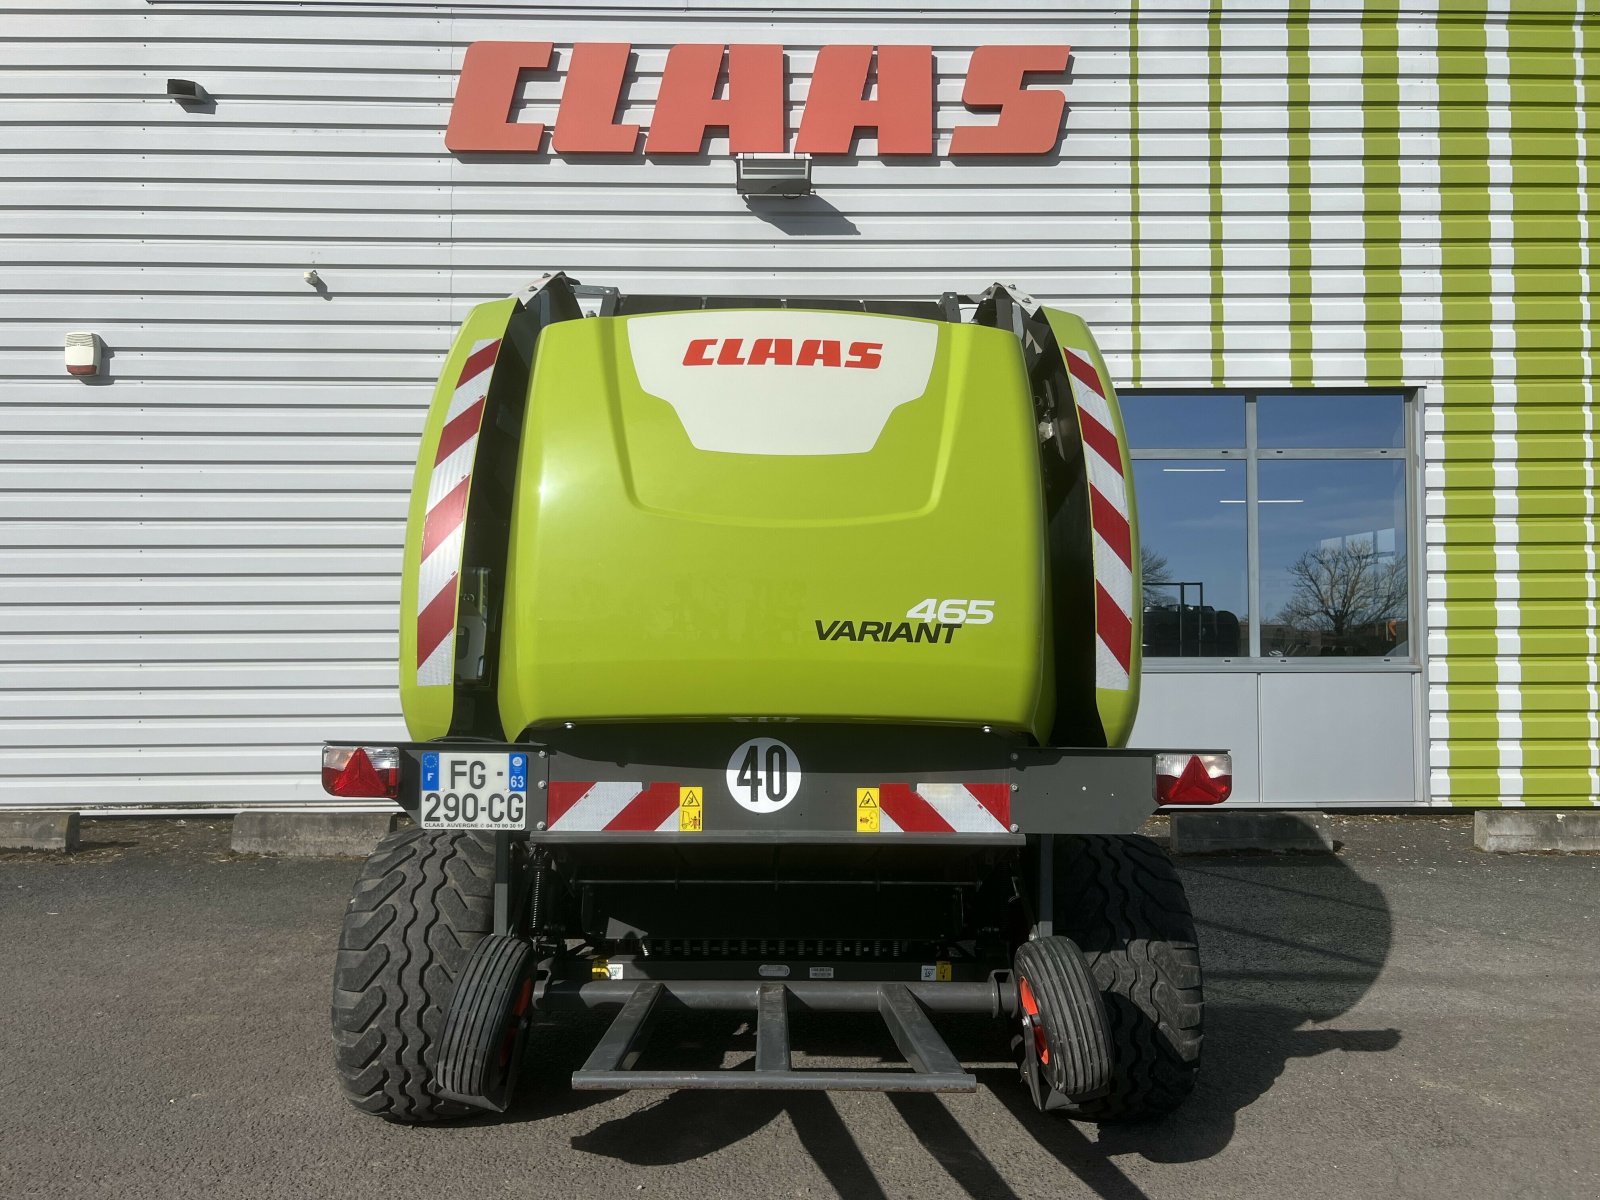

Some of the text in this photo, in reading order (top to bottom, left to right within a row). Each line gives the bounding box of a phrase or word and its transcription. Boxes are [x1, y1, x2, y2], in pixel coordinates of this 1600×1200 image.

[445, 41, 1071, 155] CLAAS
[682, 338, 884, 370] CLAAS
[906, 598, 996, 625] 465
[814, 619, 963, 644] VARIANT
[427, 772, 435, 782] F
[510, 775, 524, 788] 63
[736, 744, 788, 803] 40
[423, 792, 524, 823] 290-CG
